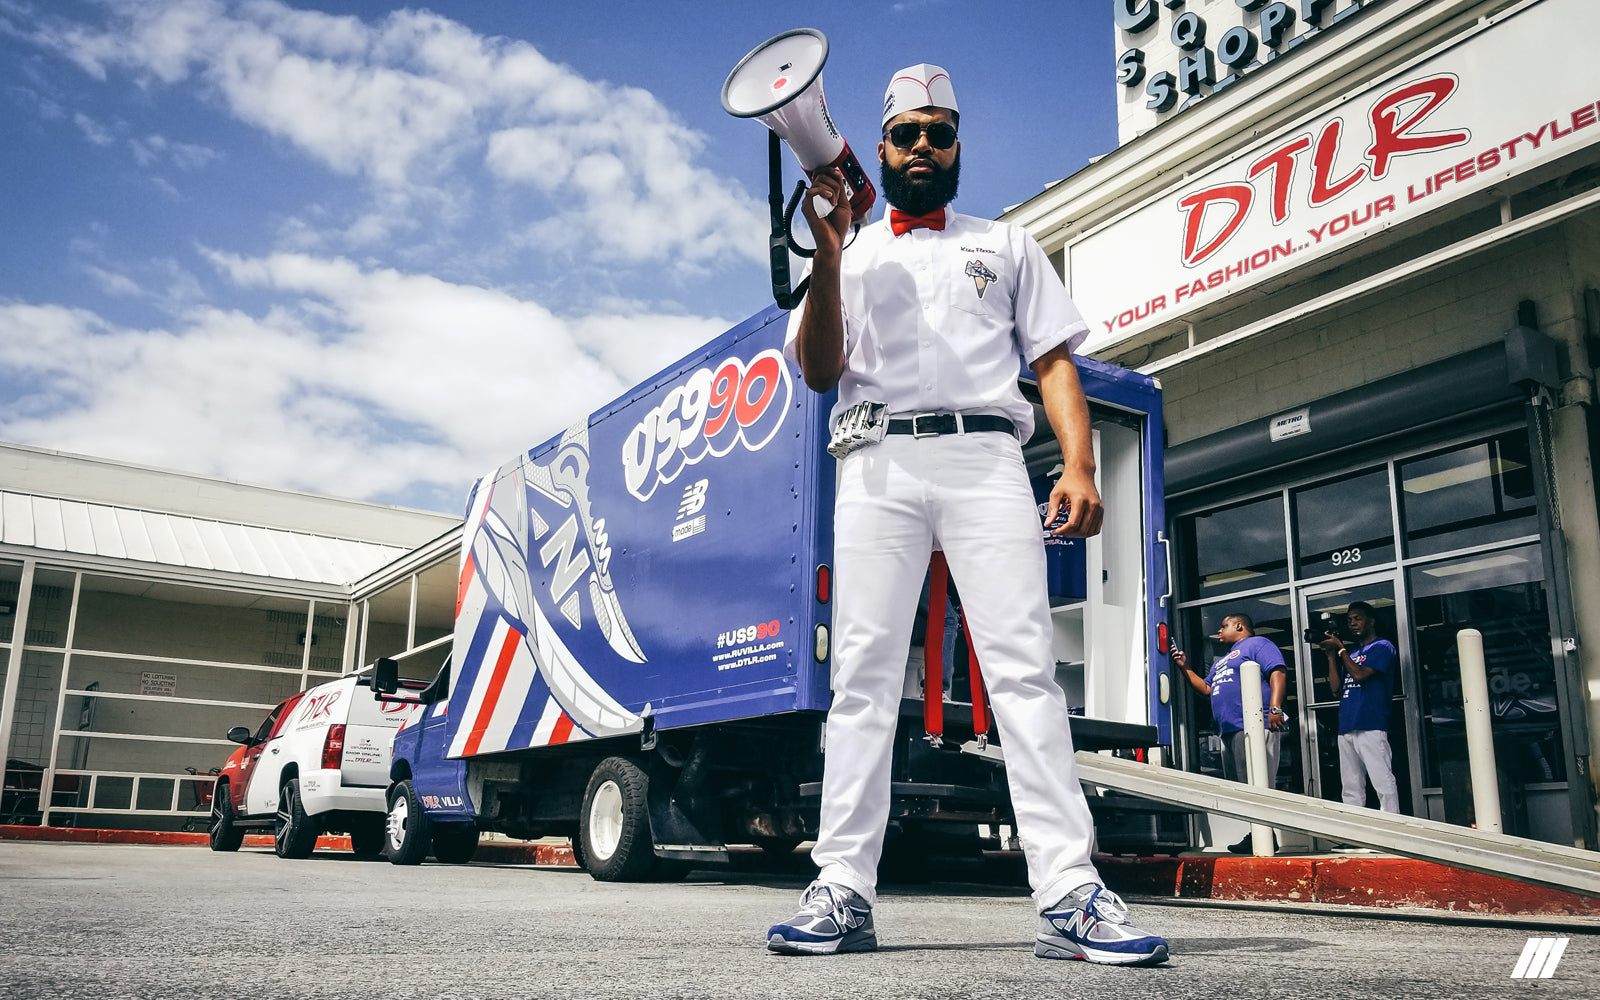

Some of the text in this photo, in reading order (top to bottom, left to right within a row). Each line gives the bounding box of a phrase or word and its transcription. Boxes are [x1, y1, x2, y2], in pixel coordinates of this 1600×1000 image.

[1178, 74, 1470, 267] DTLR
[1103, 295, 1167, 333] YOUR
[1407, 100, 1600, 203] LIFESTYLE
[622, 349, 792, 501] US990
[1276, 415, 1303, 427] METRO
[674, 523, 693, 538] made
[1331, 547, 1362, 566] 923
[716, 619, 780, 649] #US990
[712, 641, 785, 662] www.RUVILLA.com
[717, 653, 777, 672] www.DTLR.com
[299, 690, 342, 723] DTLR
[421, 795, 464, 809] DTLR VILLA
